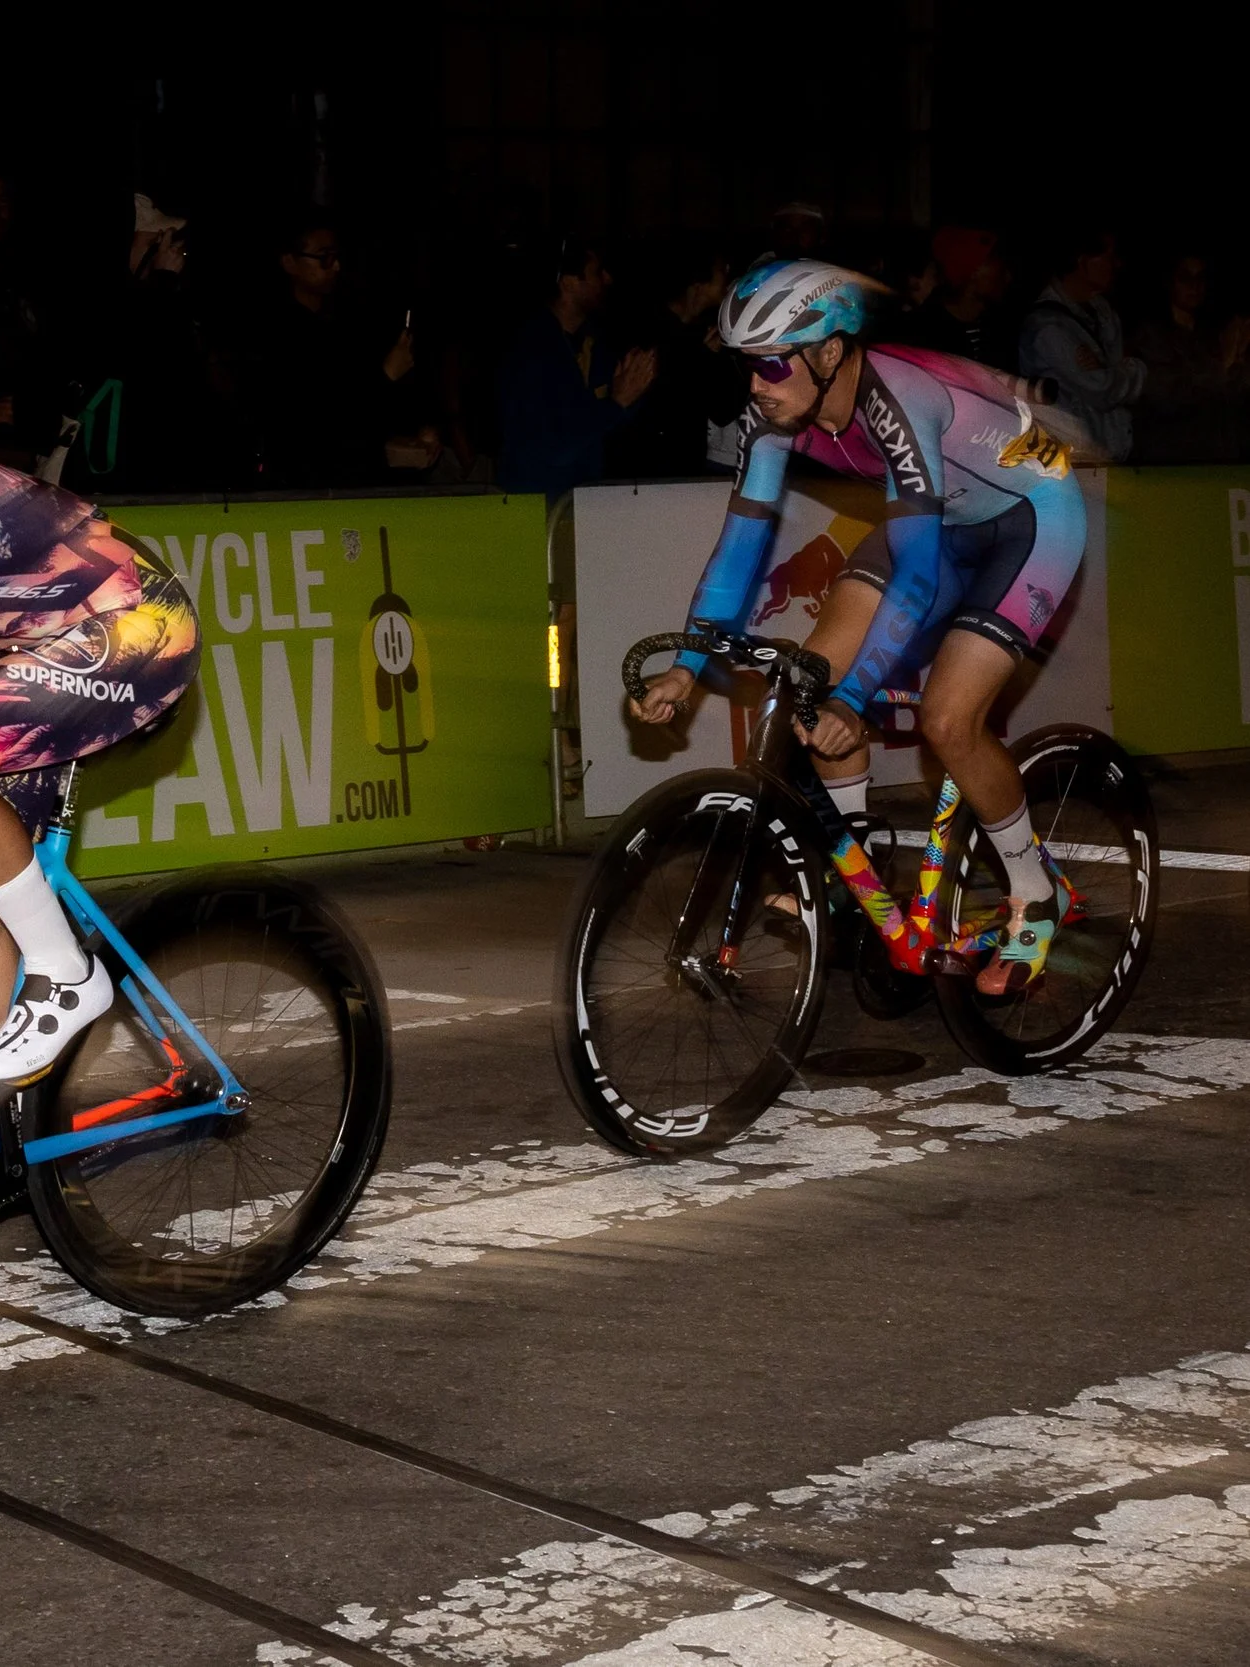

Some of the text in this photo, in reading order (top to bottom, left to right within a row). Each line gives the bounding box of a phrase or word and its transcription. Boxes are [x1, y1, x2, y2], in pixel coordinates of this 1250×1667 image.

[788, 275, 843, 321] S-WORKS
[140, 529, 333, 634] YCLE
[6, 663, 136, 703] SUPERNOVA
